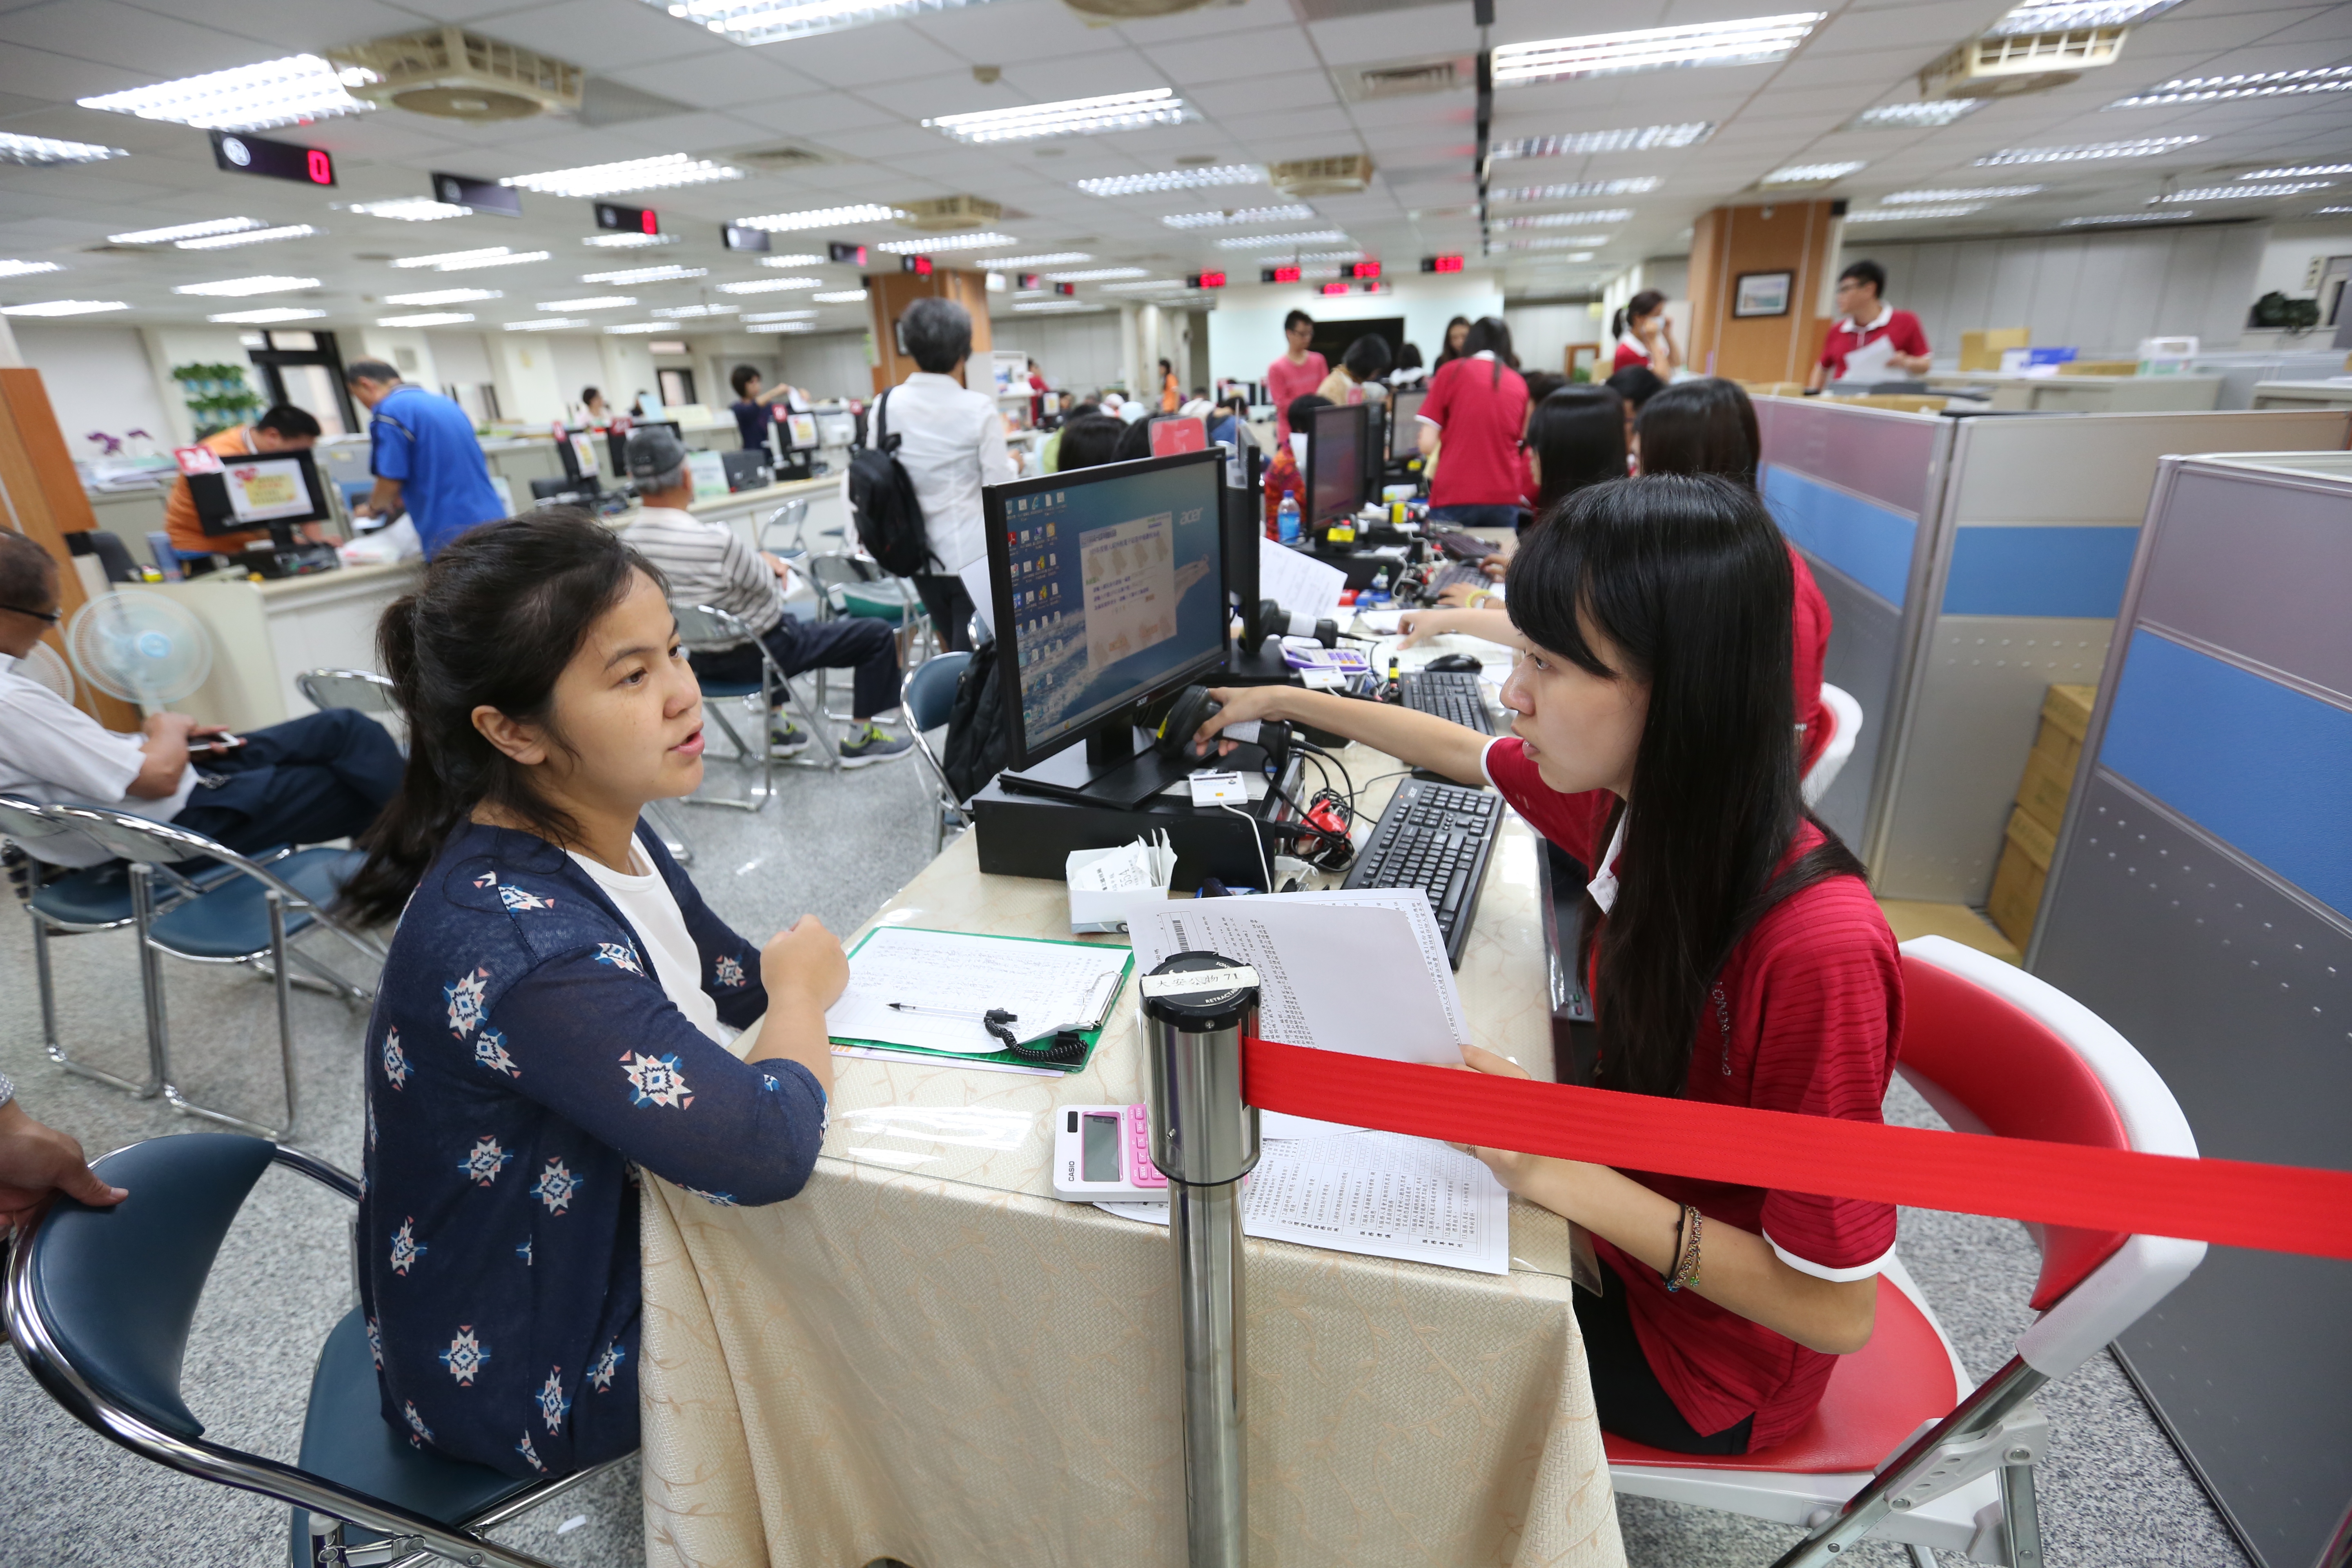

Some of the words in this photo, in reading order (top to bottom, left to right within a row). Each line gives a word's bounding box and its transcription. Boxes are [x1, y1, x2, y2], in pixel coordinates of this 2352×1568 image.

[179, 448, 213, 469] 24
[1180, 508, 1203, 525] acer
[1136, 695, 1148, 706] acer
[1116, 868, 1133, 887] 554
[1202, 916, 1219, 954] 逾法定申報期限
